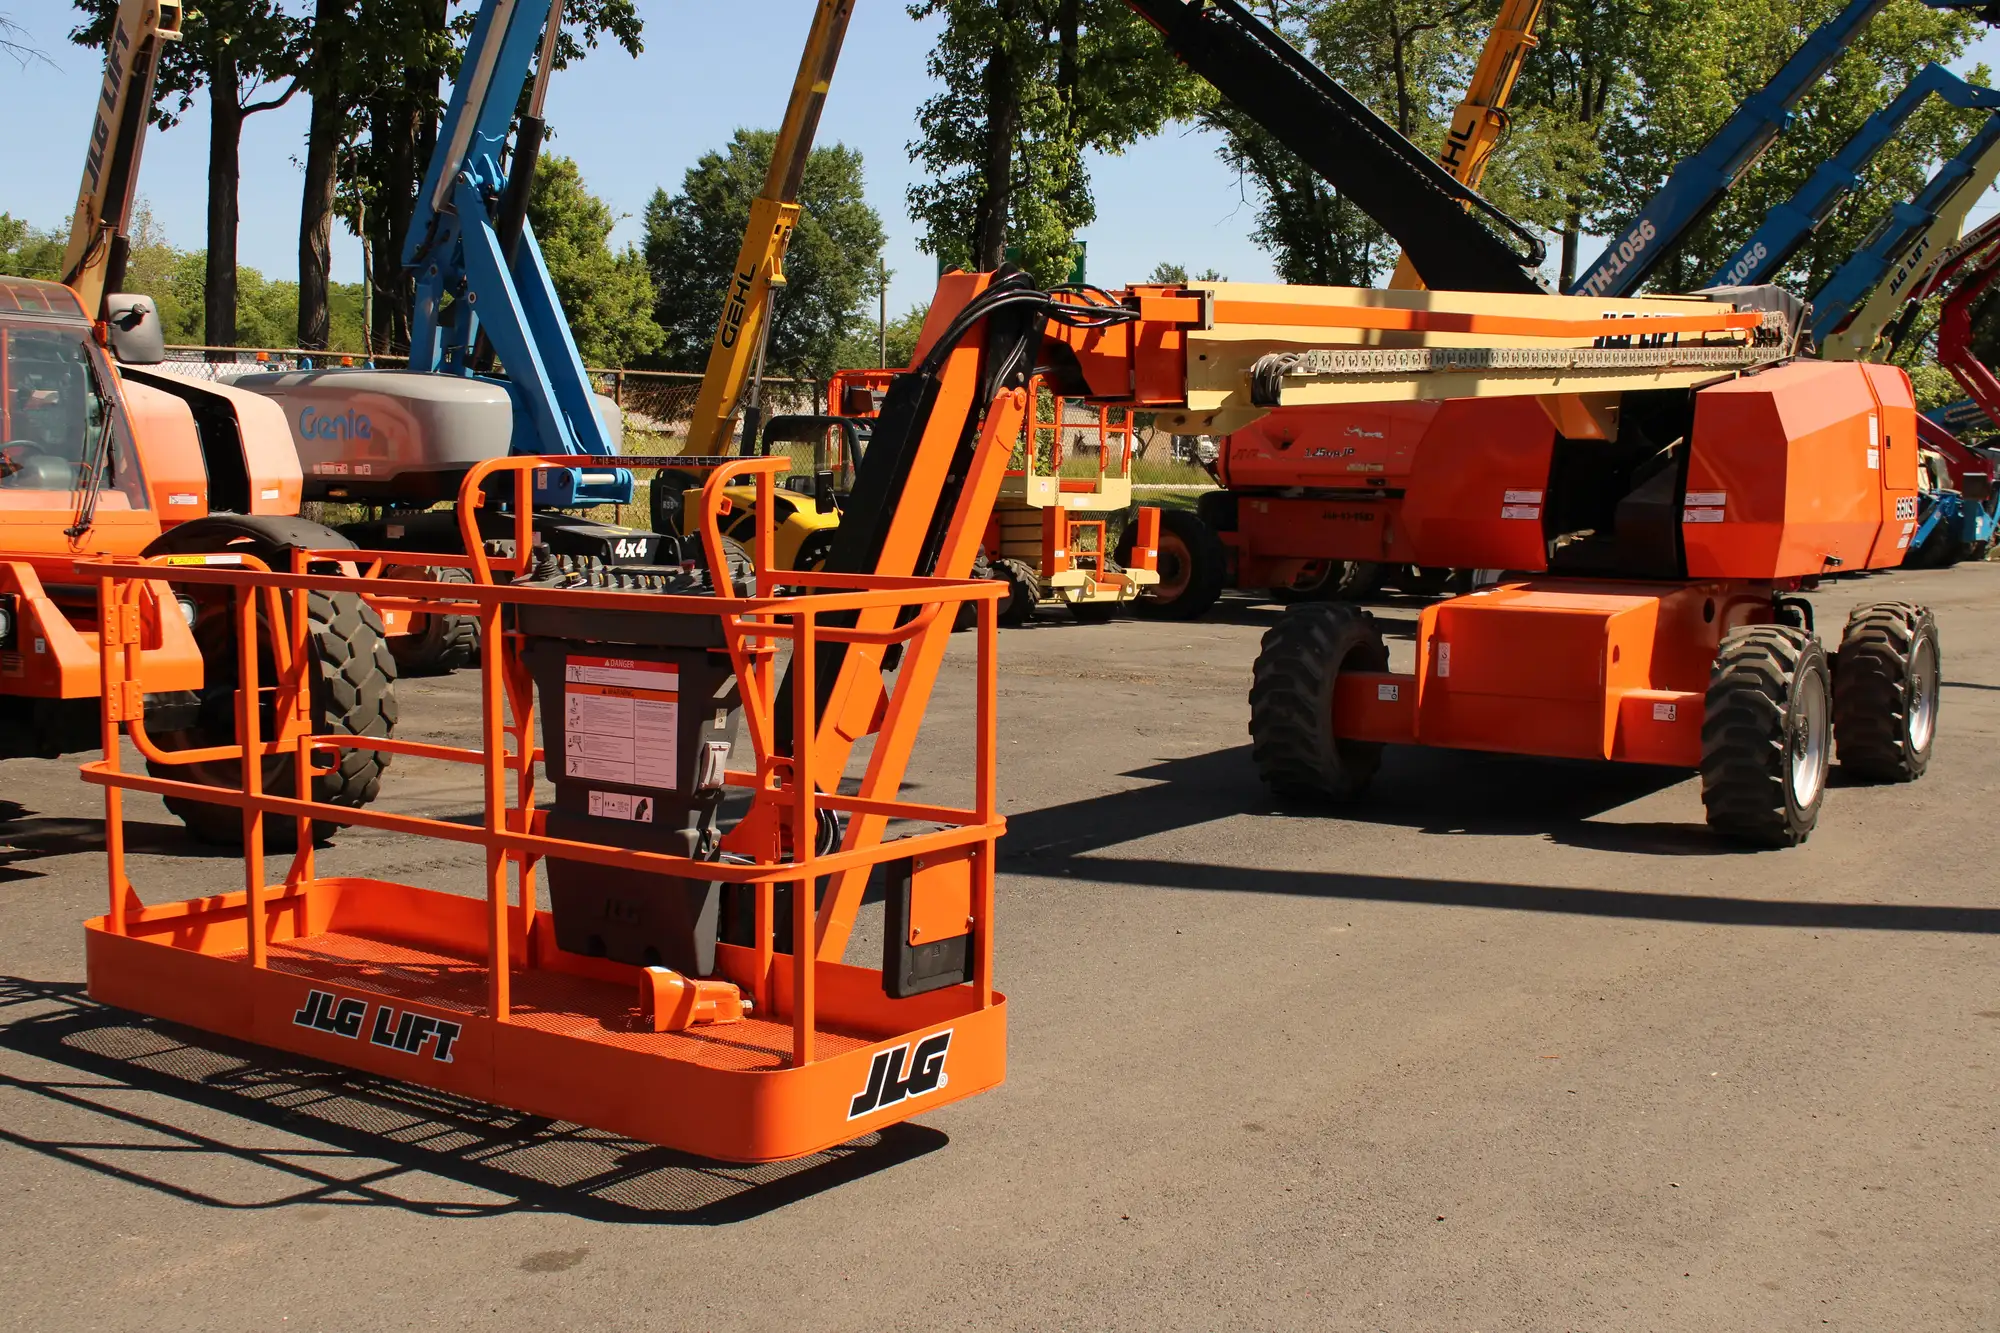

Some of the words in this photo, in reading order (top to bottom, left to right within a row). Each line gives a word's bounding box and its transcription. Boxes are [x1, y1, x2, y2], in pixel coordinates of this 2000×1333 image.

[87, 112, 110, 193] JLG
[102, 17, 130, 115] LIFT
[1889, 267, 1908, 297] JLG
[1906, 236, 1930, 271] LIFT
[721, 263, 757, 349] GEHL
[300, 406, 372, 440] Genie
[174, 556, 204, 564] CAUTION
[615, 538, 648, 558] 4x4
[610, 659, 635, 669] DANGER
[292, 988, 369, 1040] JLG
[370, 1005, 463, 1063] LIFT
[846, 1028, 954, 1122] JLG
